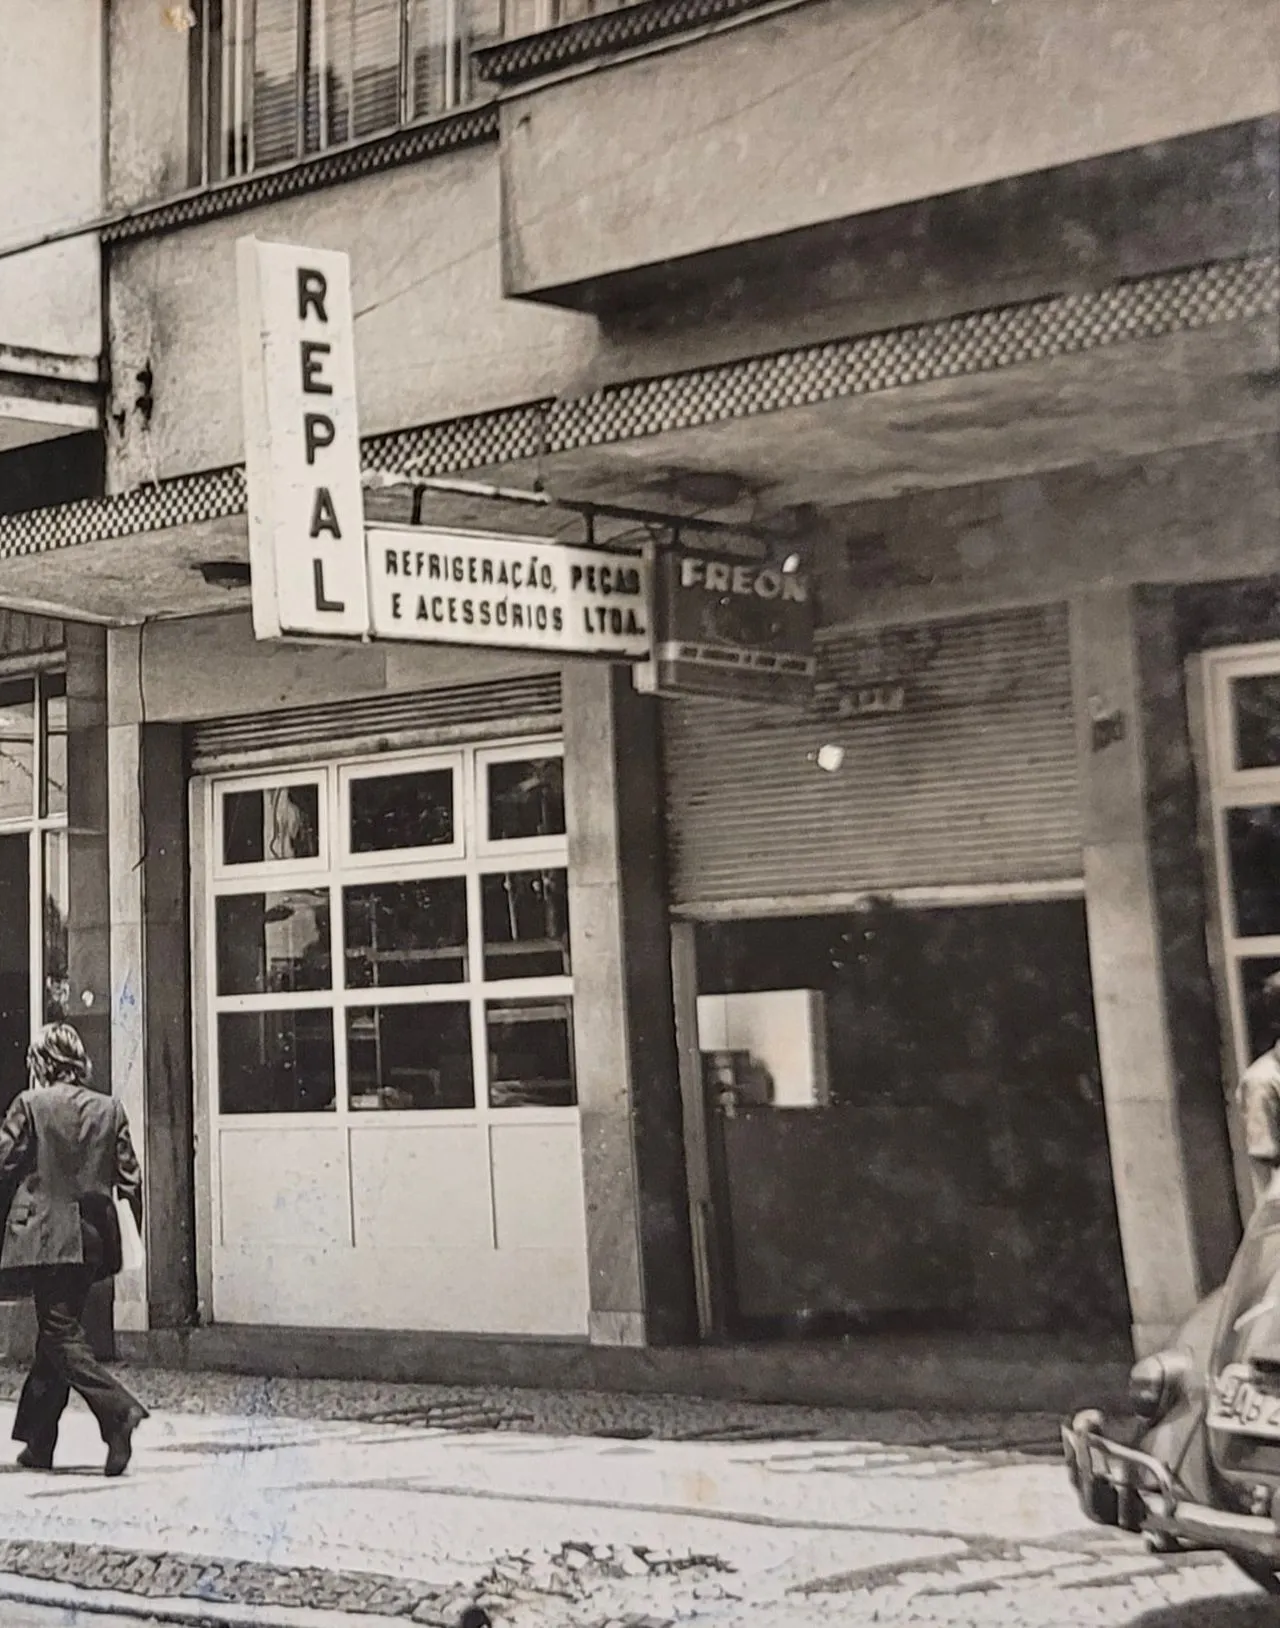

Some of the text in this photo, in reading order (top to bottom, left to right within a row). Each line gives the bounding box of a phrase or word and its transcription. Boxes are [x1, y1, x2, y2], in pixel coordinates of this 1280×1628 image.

[297, 267, 345, 613] REPAL
[385, 549, 557, 594] REFRIGERAÇÃO,
[681, 558, 808, 602] FREON
[392, 593, 402, 619] E
[416, 595, 563, 632] ACESSÓRIOS
